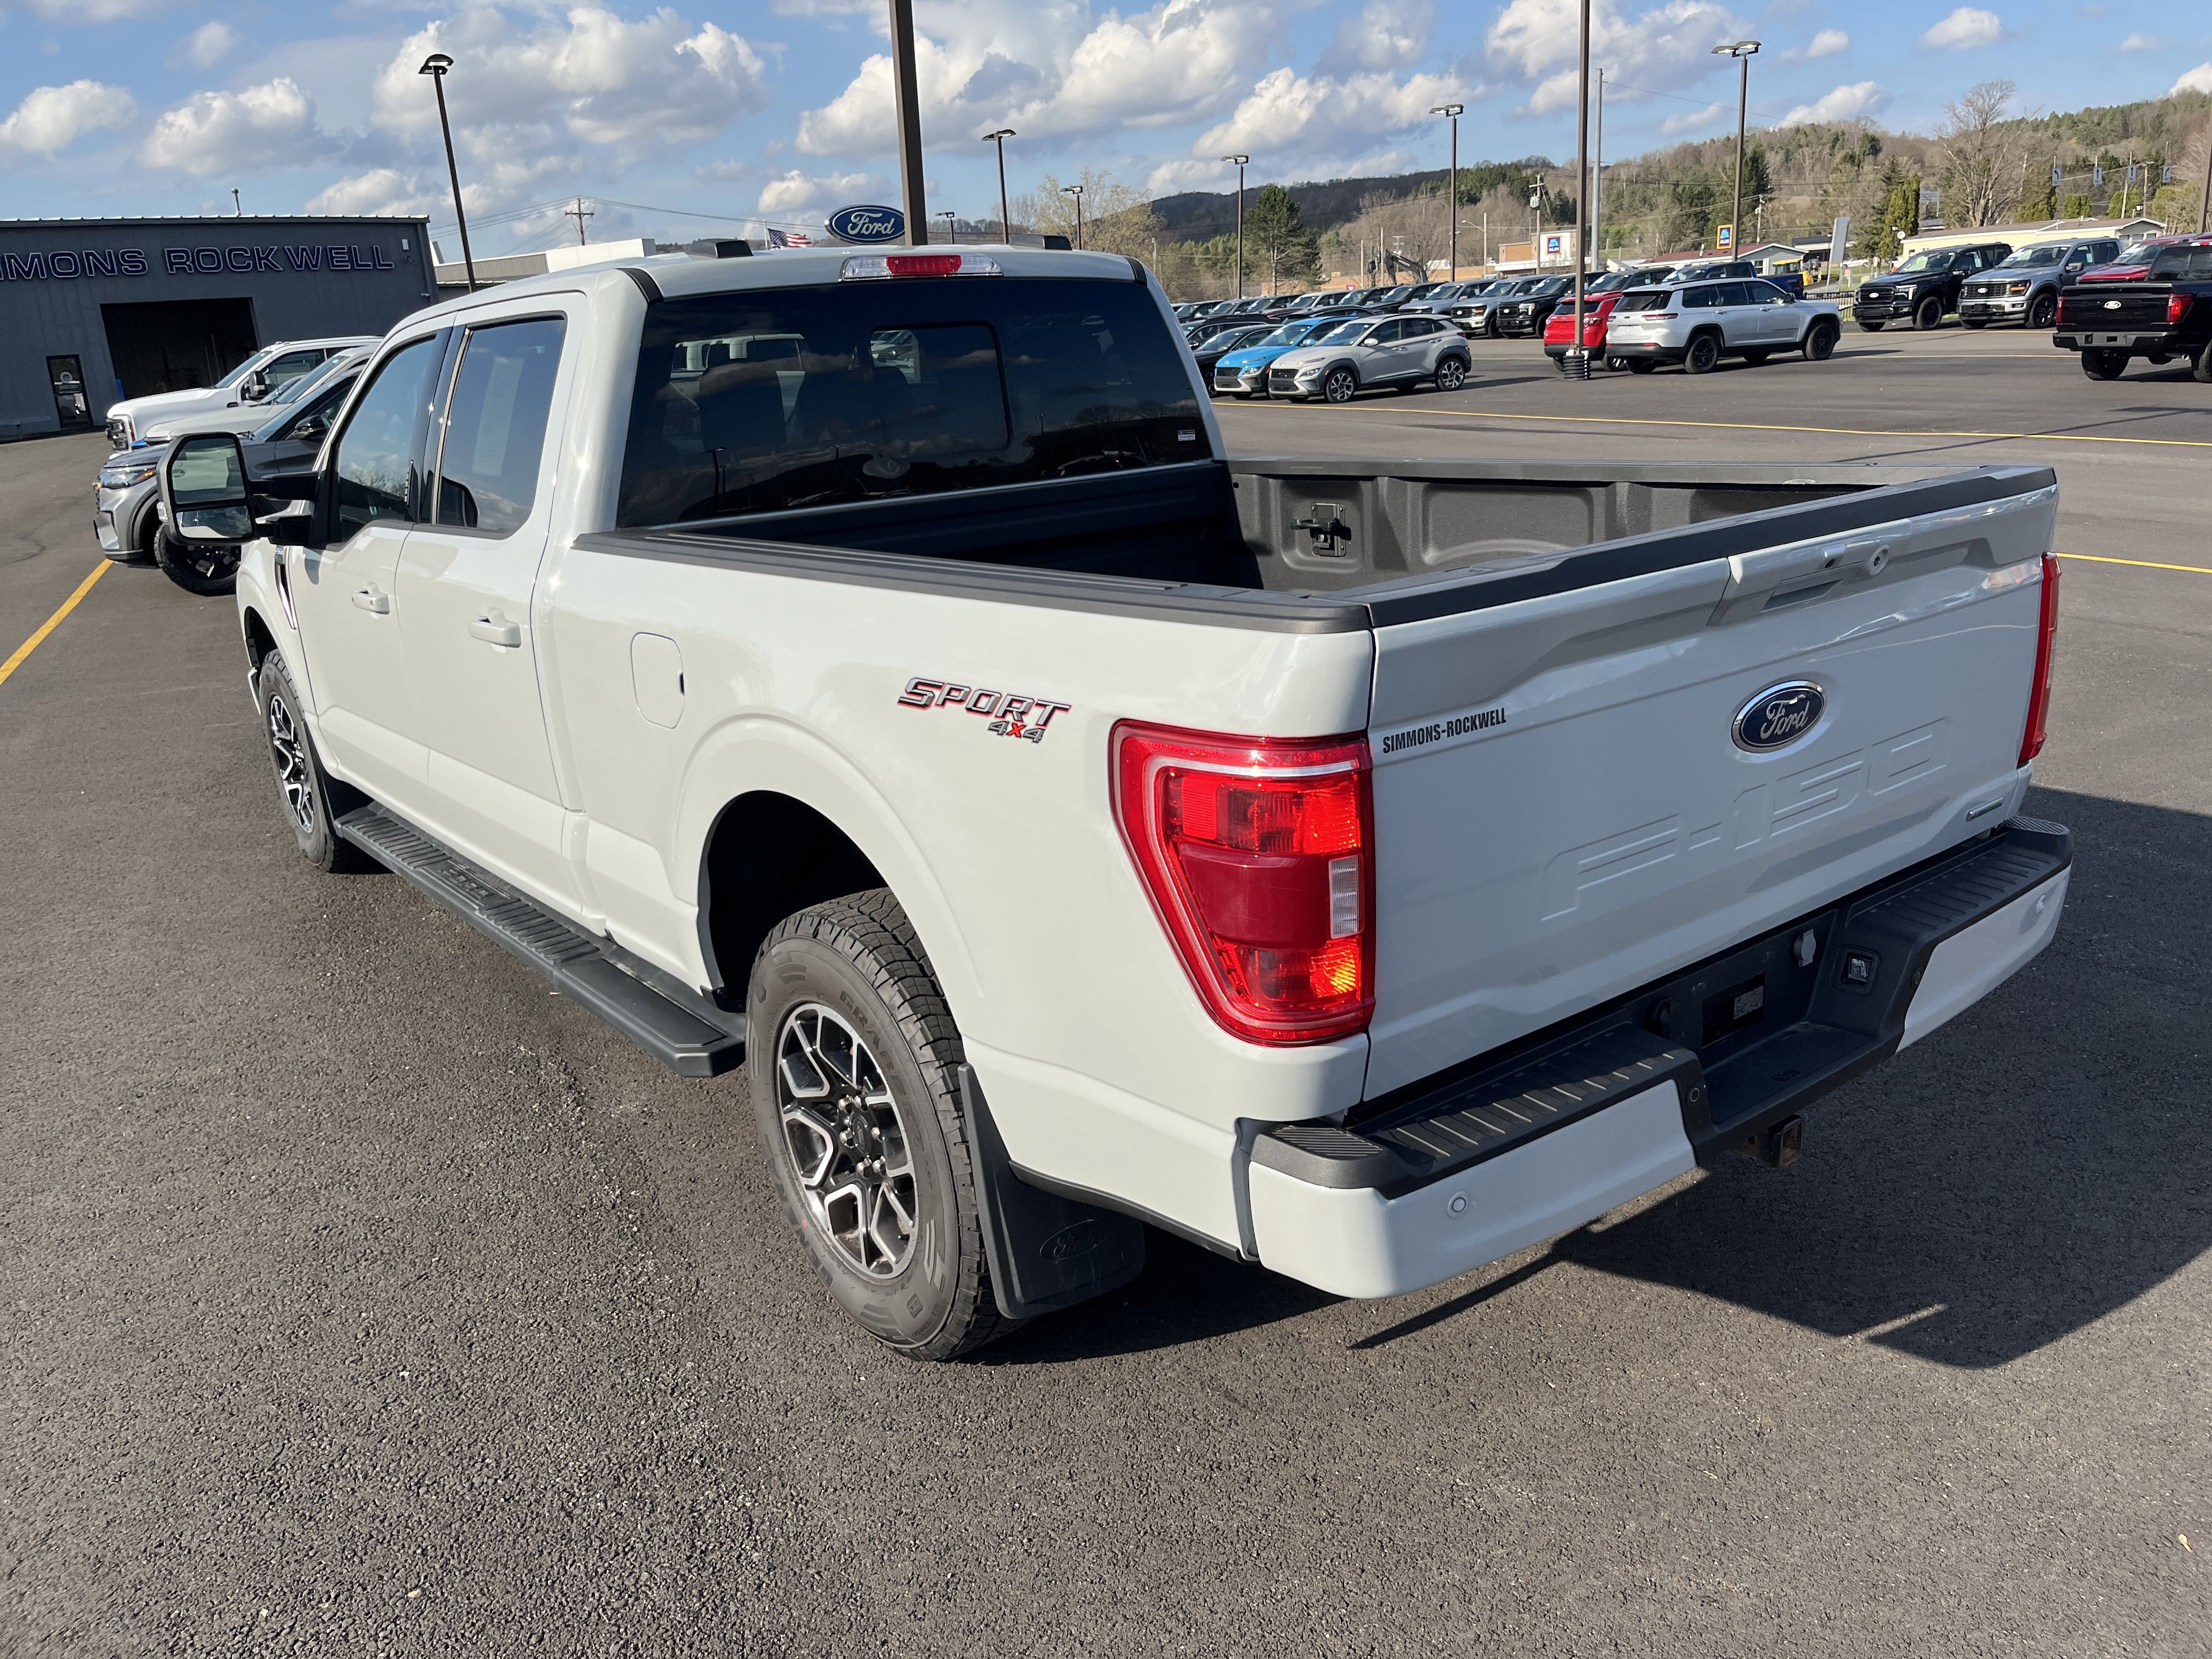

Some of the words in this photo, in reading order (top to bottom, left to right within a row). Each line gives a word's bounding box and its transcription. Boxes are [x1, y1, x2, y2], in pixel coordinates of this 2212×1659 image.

[847, 212, 895, 235] Ford
[0, 249, 148, 281] MONS
[165, 245, 395, 274] ROCKWELL
[897, 676, 1072, 729] SPORT
[1760, 693, 1810, 740] Ford
[1383, 708, 1506, 754] SIMMONS-ROCKWELL
[1541, 717, 1952, 921] F-150
